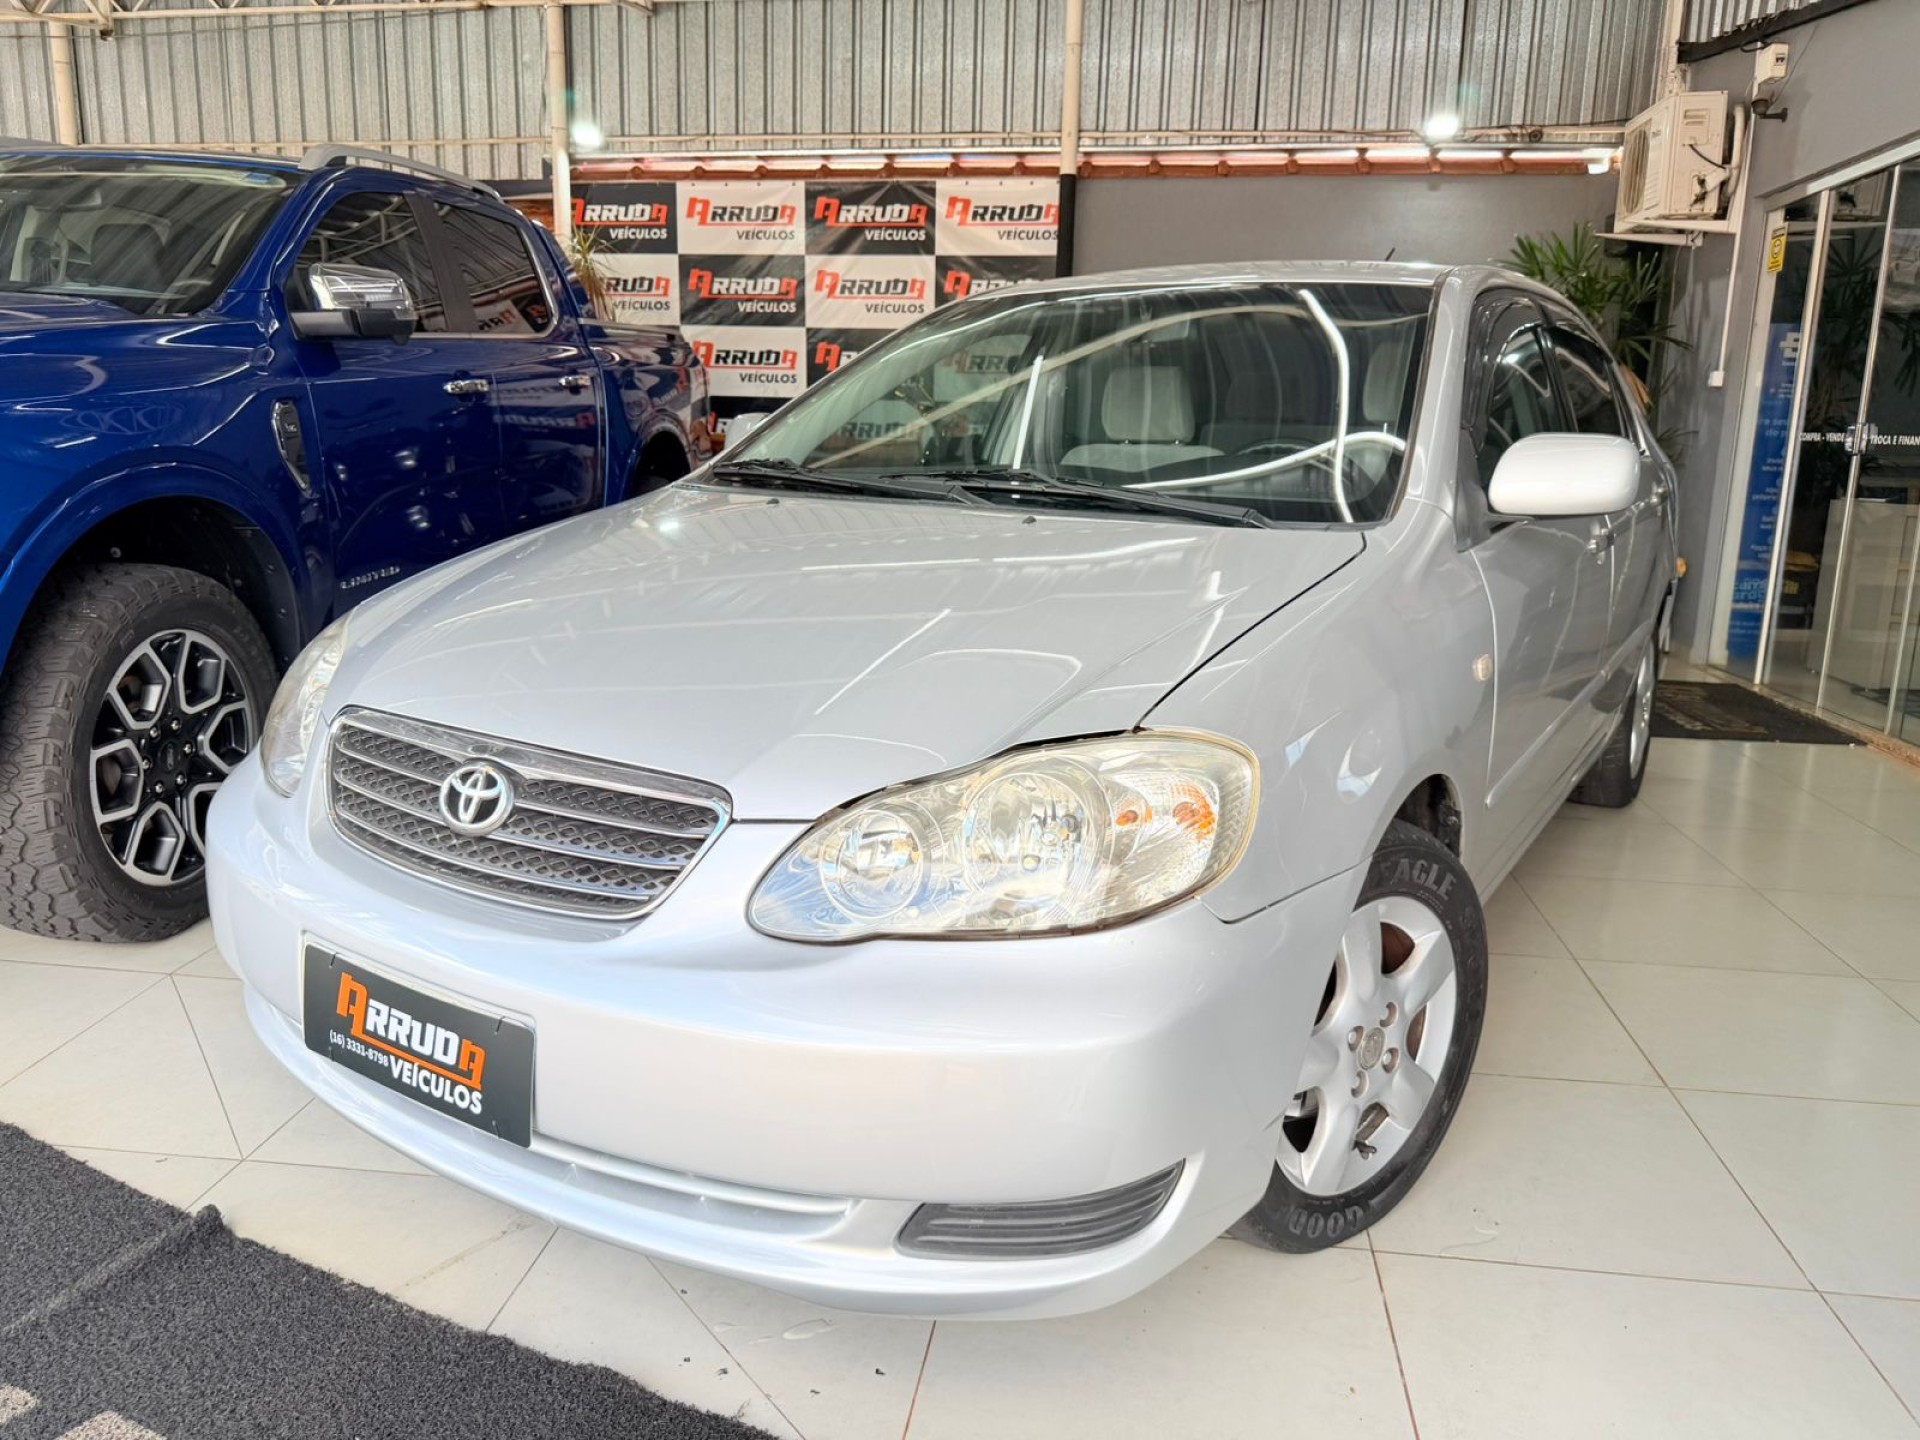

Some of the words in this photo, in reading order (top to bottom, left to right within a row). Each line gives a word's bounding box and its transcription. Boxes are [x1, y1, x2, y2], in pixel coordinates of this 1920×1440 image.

[685, 197, 797, 226] ARRUDA
[813, 196, 929, 227] ARRUDA
[945, 196, 1060, 226] ARRUDA
[609, 227, 667, 240] VEÍCULOS
[735, 227, 796, 241] VEÍCULOS
[864, 227, 927, 241] VEÍCULOS
[997, 227, 1059, 241] VEÍCULOS
[688, 268, 798, 299] ARRUDA
[813, 269, 927, 300] ARRUDA
[614, 299, 671, 311] VEÍCULOS
[737, 300, 797, 313] VEÍCULOS
[865, 302, 925, 314] VEÍCULOS
[694, 341, 798, 370] ARRUDA
[739, 371, 797, 384] VEÍCULOS
[1871, 434, 1891, 445] TROCA
[1380, 858, 1456, 900] EAGLE
[336, 971, 487, 1091] ARRUDA
[389, 1054, 483, 1115] VEÍCULOS
